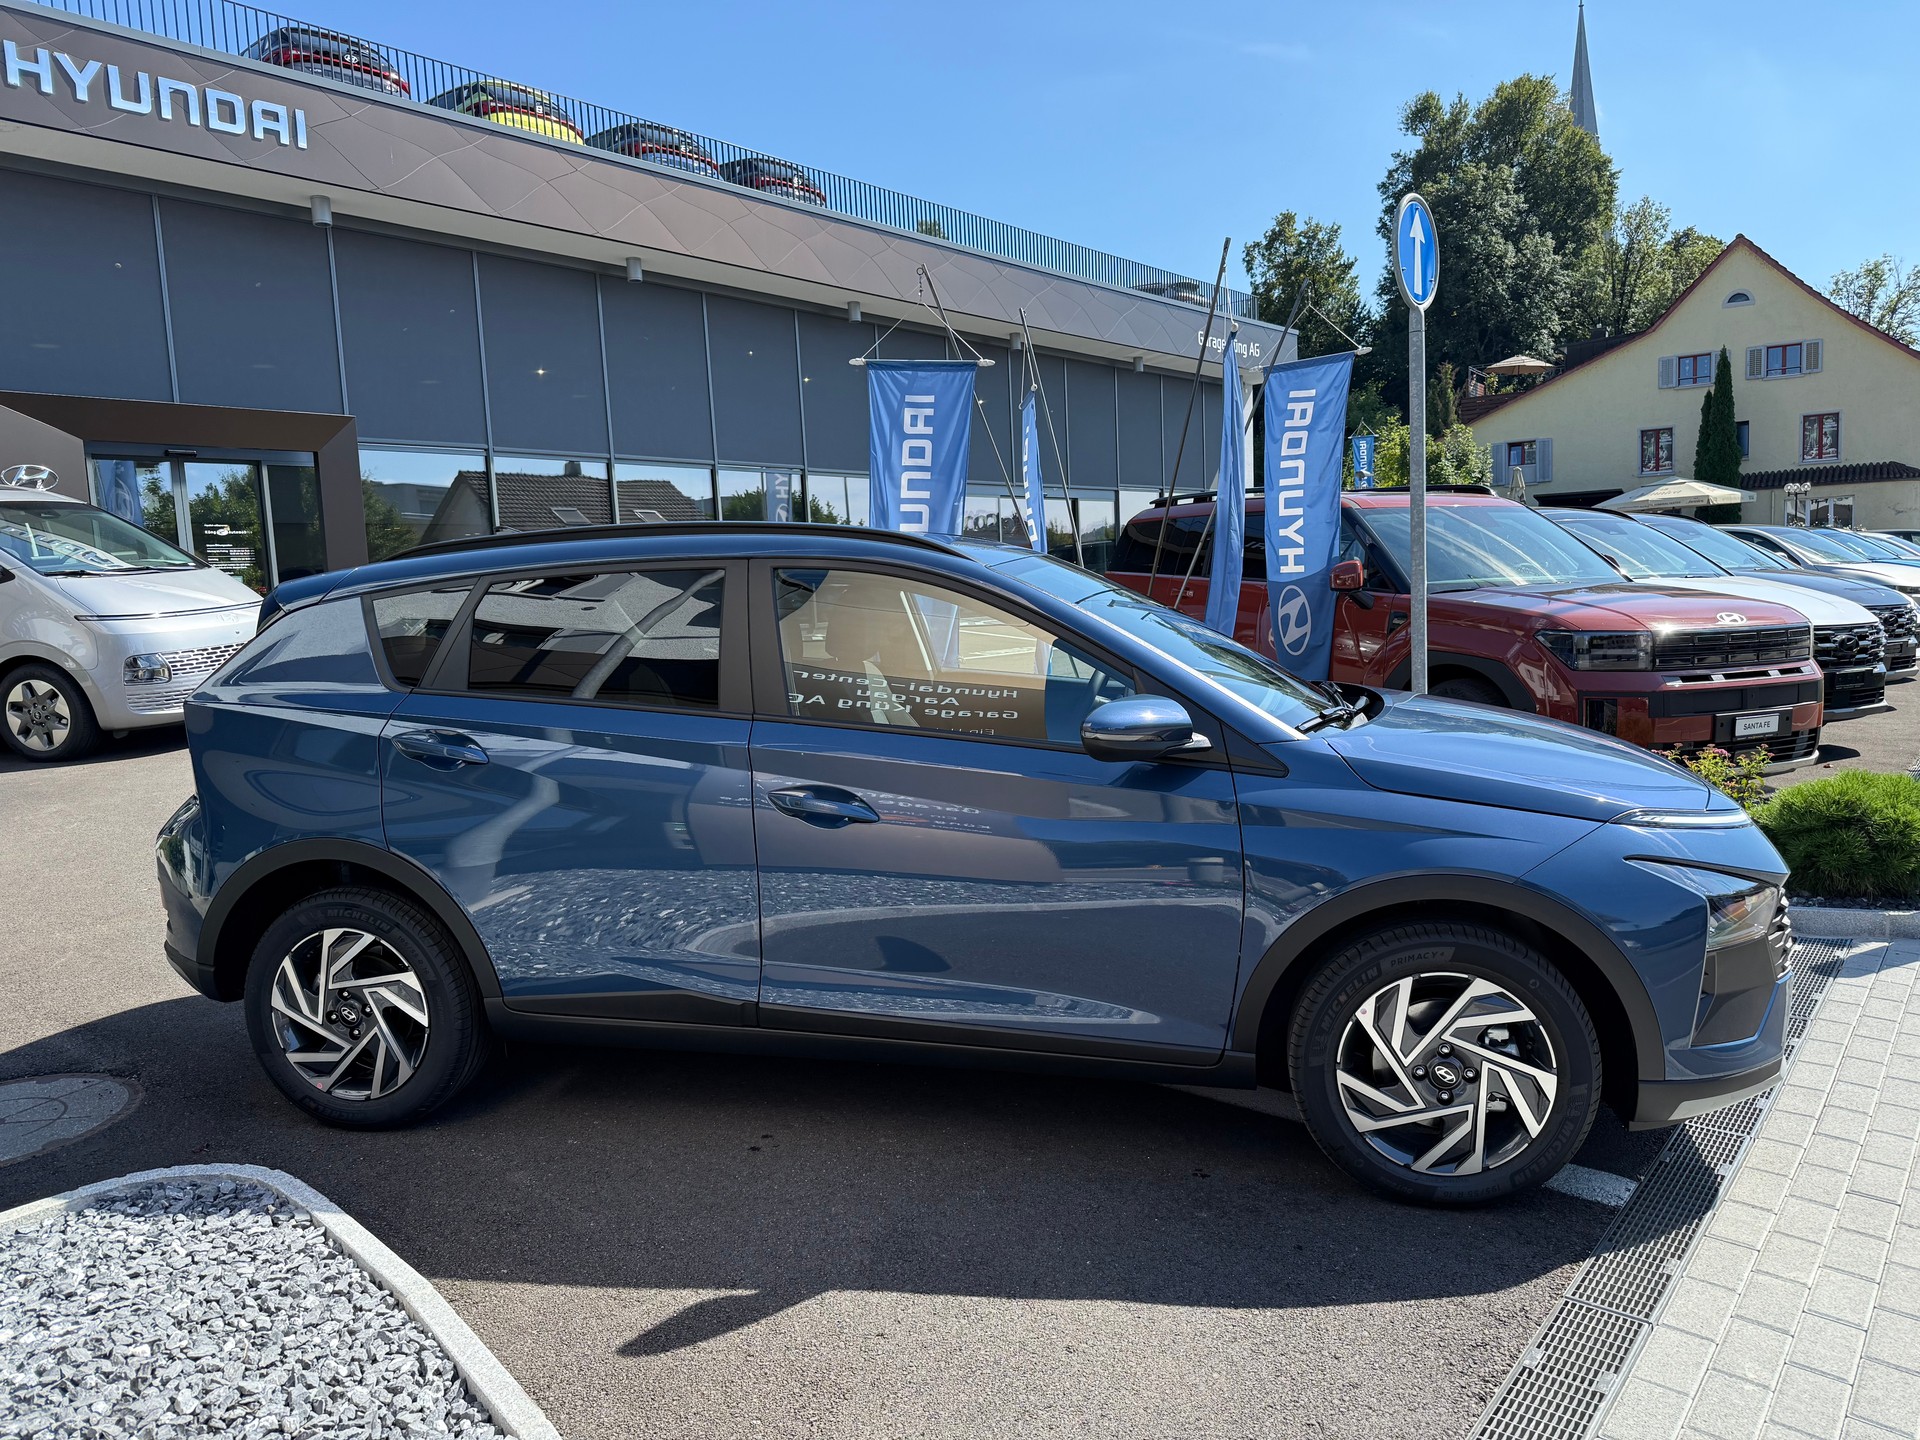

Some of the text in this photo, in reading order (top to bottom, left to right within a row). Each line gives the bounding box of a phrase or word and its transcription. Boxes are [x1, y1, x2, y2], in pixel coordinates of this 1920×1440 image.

[3, 39, 308, 149] HYUNDAI
[1249, 342, 1260, 357] AG
[1743, 720, 1771, 731] SANTA FE
[327, 908, 392, 933] MICHELIN
[1390, 951, 1438, 967] PRIMACY
[1320, 965, 1379, 1030] MICHELIN
